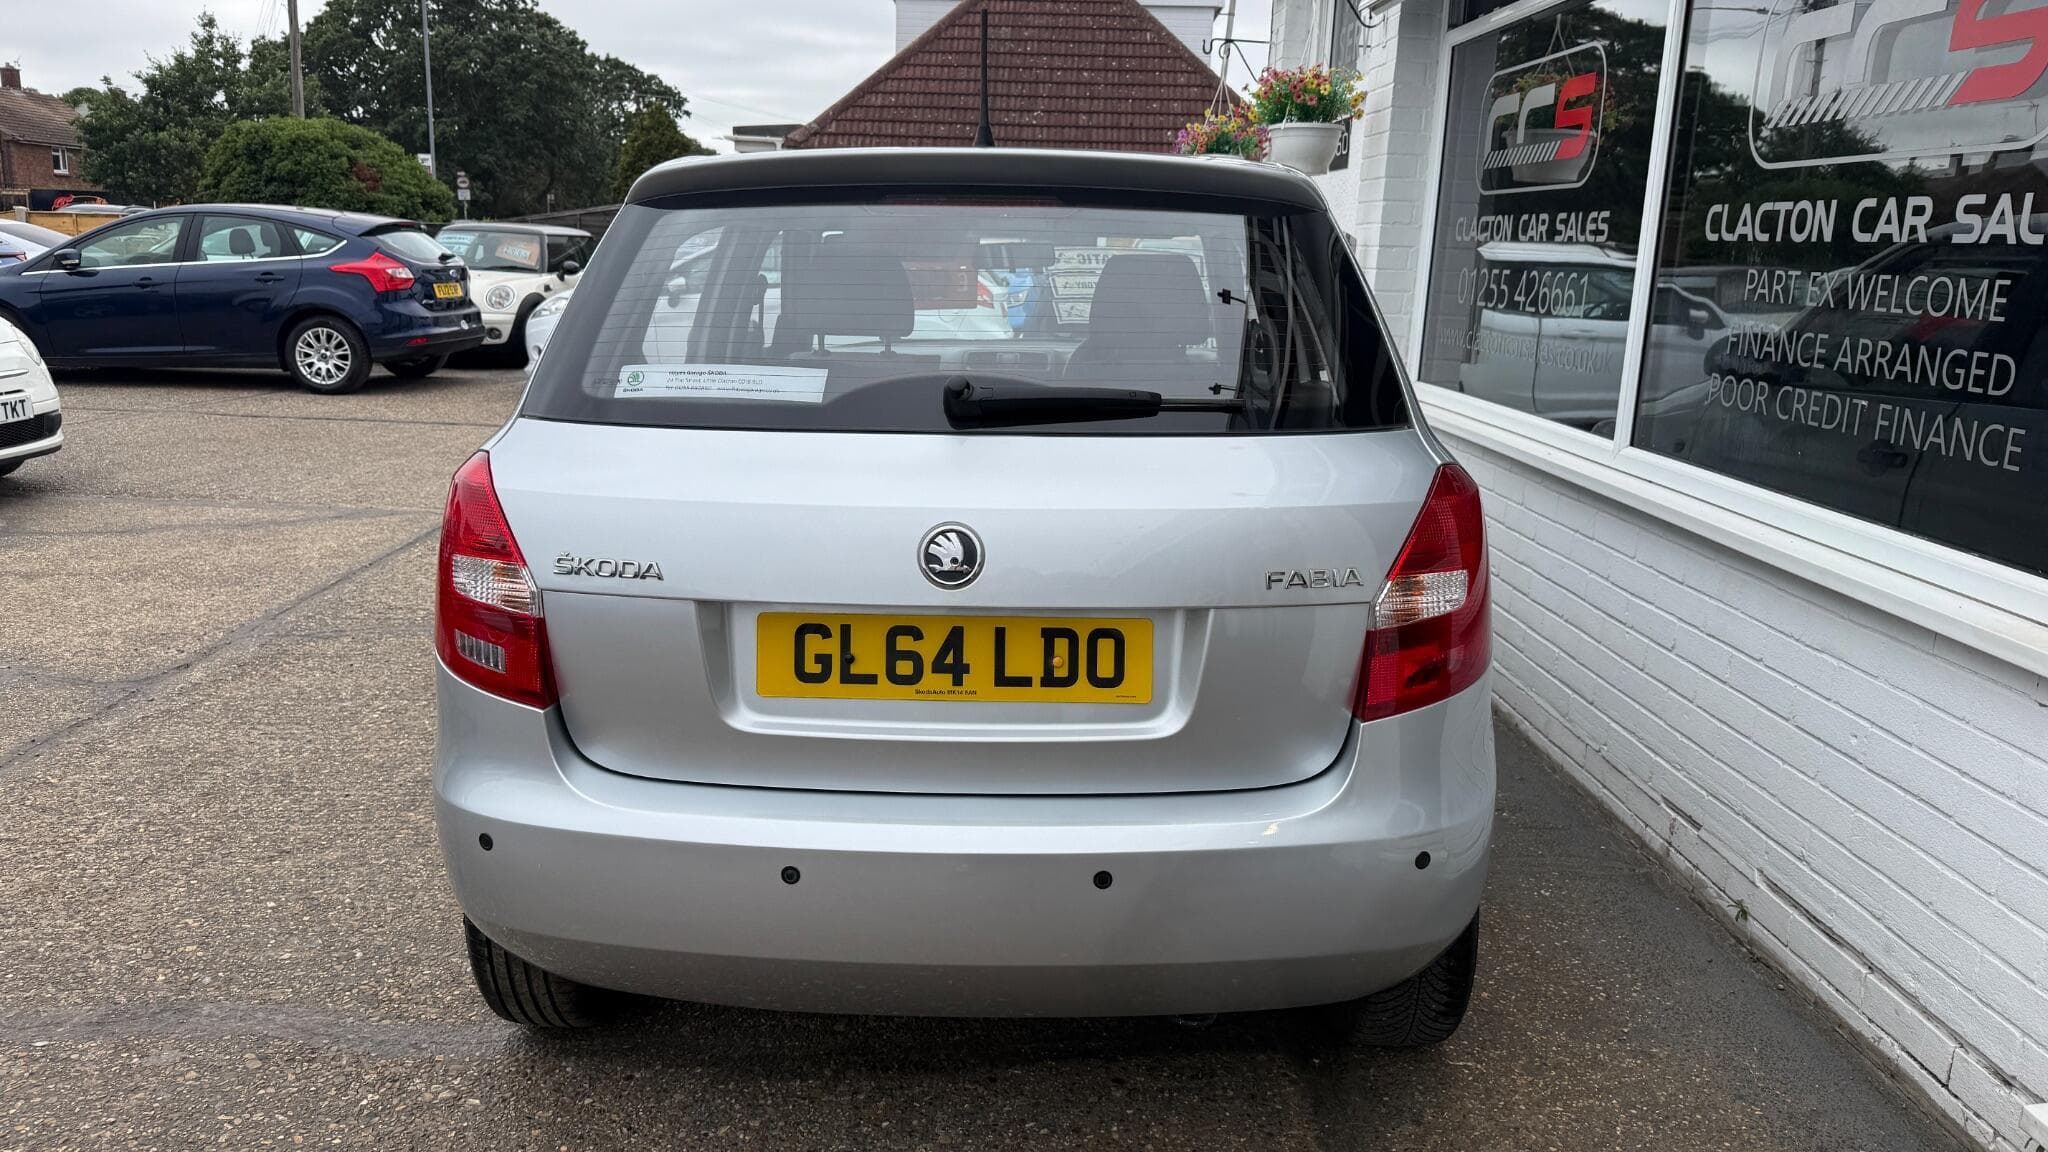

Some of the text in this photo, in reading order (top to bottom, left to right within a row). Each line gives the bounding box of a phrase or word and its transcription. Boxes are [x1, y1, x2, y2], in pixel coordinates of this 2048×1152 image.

[1455, 210, 1611, 243] CLACTON CAR SALES
[1704, 192, 2048, 245] CLACTON CAR SAL
[1457, 267, 1590, 319] 01255 426661
[1743, 268, 2012, 323] PART EX WELCOME
[1726, 326, 2017, 397] FINANCE ARRANGED
[1, 399, 26, 420] TKT
[1706, 372, 2027, 472] POOR CREDIT FINANCE
[553, 551, 664, 581] ŠKODA
[1266, 568, 1364, 590] FABIA
[794, 623, 1125, 689] GL64 LDO
